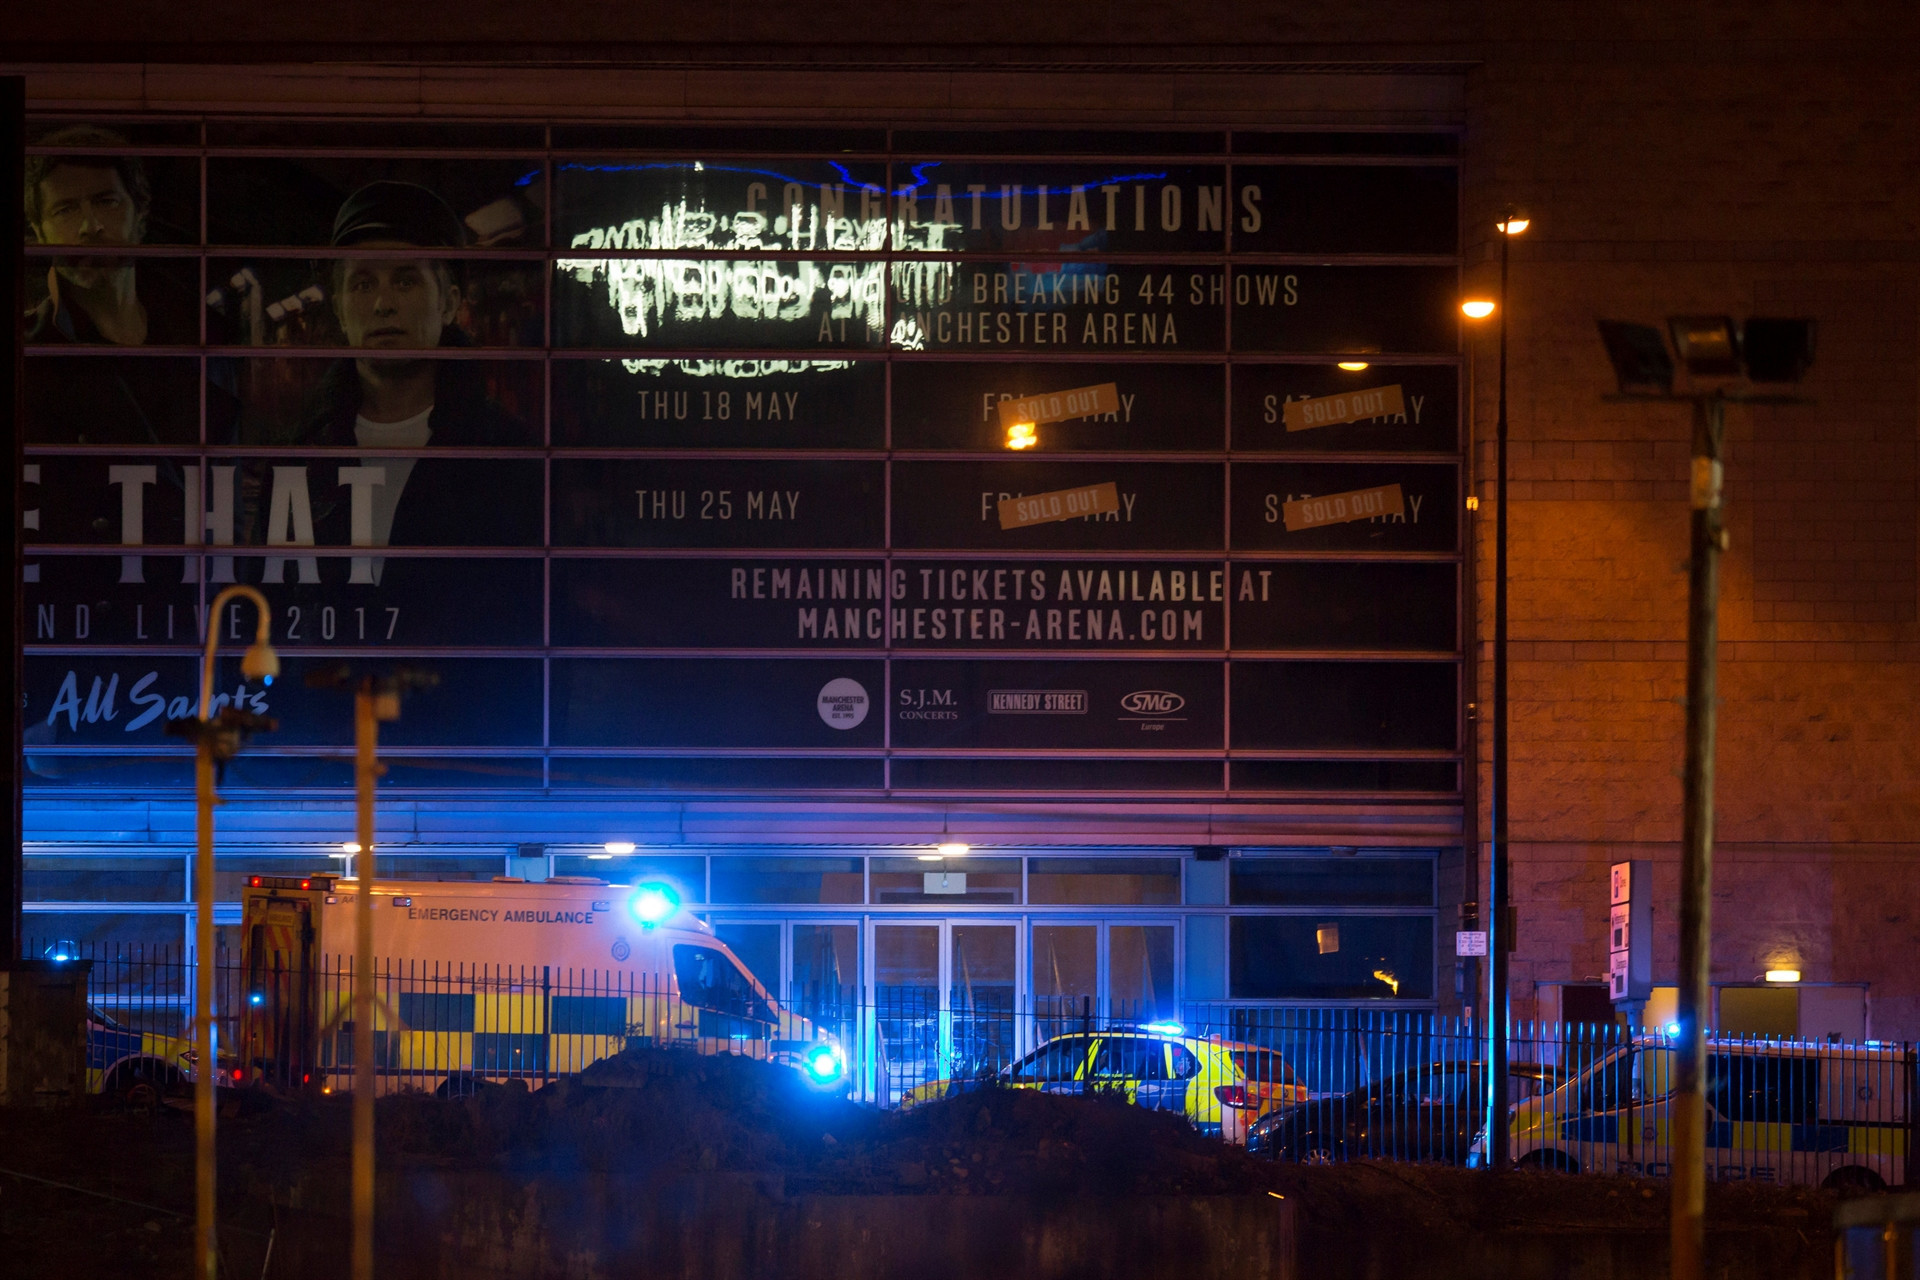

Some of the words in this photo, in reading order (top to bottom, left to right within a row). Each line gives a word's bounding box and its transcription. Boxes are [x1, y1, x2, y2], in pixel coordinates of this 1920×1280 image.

[973, 273, 1120, 305] BREAKING
[1138, 274, 1174, 304] 44
[1190, 274, 1298, 306] SHOWS
[1082, 312, 1178, 344] ARENA
[637, 390, 688, 420] THU
[702, 391, 730, 420] 18
[746, 391, 799, 421] MAY
[1016, 396, 1062, 422] SOLD
[1067, 389, 1098, 414] OUT
[1303, 398, 1346, 424] SOLD
[1352, 392, 1384, 416] OUT
[635, 490, 686, 519] THU
[700, 490, 732, 519] 25
[747, 490, 800, 520] MAY
[1016, 495, 1061, 522] SOLD
[1067, 489, 1098, 514] OUT
[1303, 497, 1346, 524] SOLD
[1352, 491, 1384, 516] OUT
[109, 464, 386, 584] THAT
[731, 568, 906, 600] REMAINING
[919, 569, 1046, 601] TICKETS
[1057, 570, 1223, 602] AVAILABLE
[1239, 570, 1272, 602] AT
[287, 605, 400, 640] 2017
[798, 607, 1202, 641] MANCHESTER-ARENA.COM
[47, 670, 119, 733] All
[822, 696, 864, 704] MANCHESTER
[832, 704, 854, 712] ARENA
[900, 689, 957, 709] S.J.M.
[993, 694, 1040, 710] KENNEDY
[1045, 694, 1082, 710] STREET
[1131, 694, 1172, 710] SMG
[900, 711, 958, 720] CONCERTS
[1141, 723, 1165, 731] Europe
[408, 908, 499, 922] EMERGENCY
[504, 911, 594, 924] AMBULANCE
